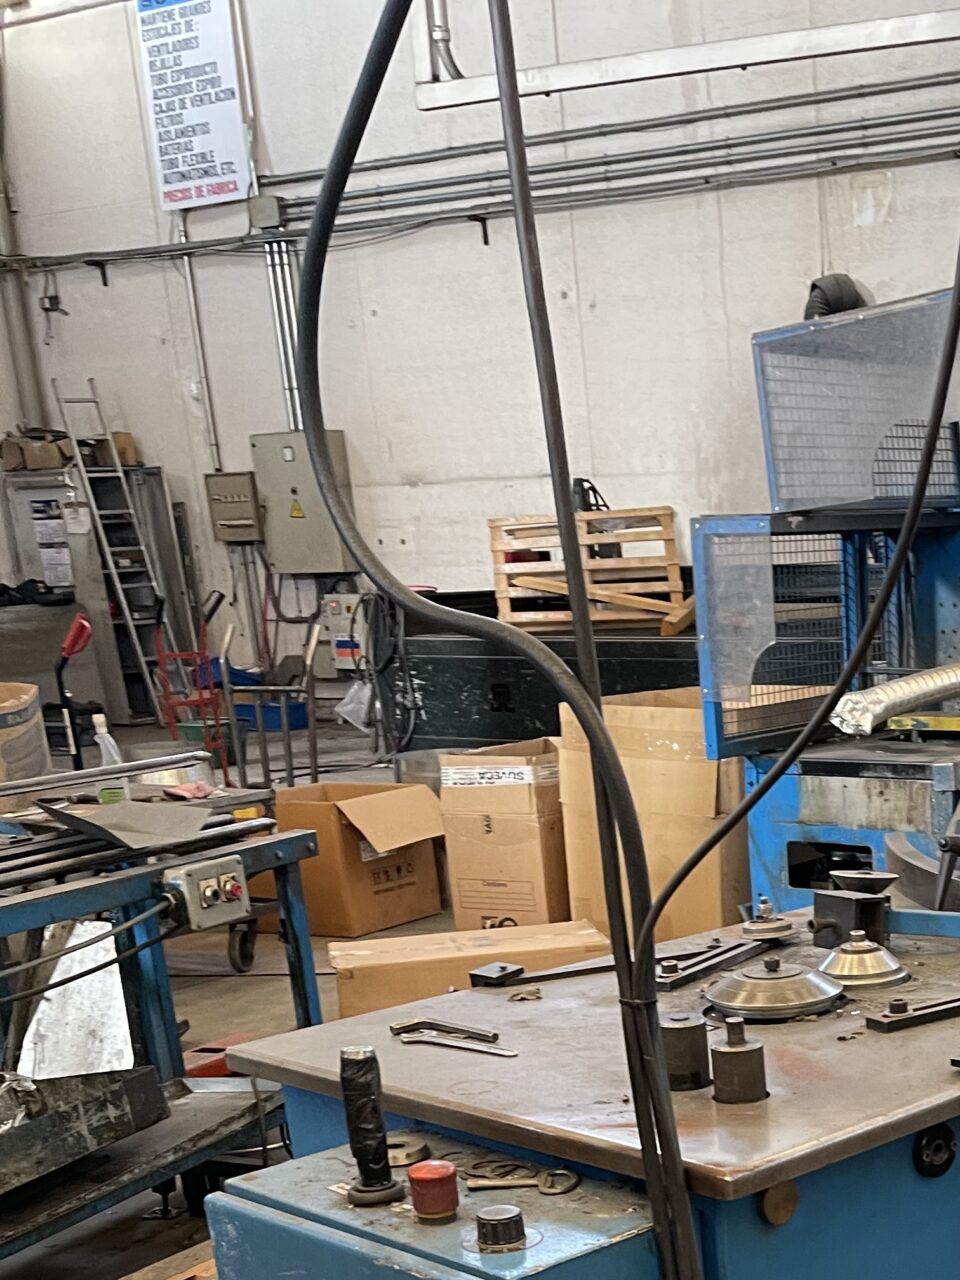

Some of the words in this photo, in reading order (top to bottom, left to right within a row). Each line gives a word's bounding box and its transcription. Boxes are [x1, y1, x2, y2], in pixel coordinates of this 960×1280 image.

[147, 35, 200, 58] VENTILADORES
[149, 54, 183, 73] REJILLAS
[150, 71, 169, 87] TUBO
[153, 81, 195, 100] ACCESORIOS
[153, 99, 177, 115] CAJAS
[178, 97, 188, 110] DE
[155, 112, 184, 129] FILTROS
[159, 121, 211, 142] AISLAMIENTOS
[160, 156, 180, 171] TUBO
[181, 150, 216, 167] FLEXIBLE
[163, 187, 193, 203] PRECIOS
[194, 185, 206, 199] DE
